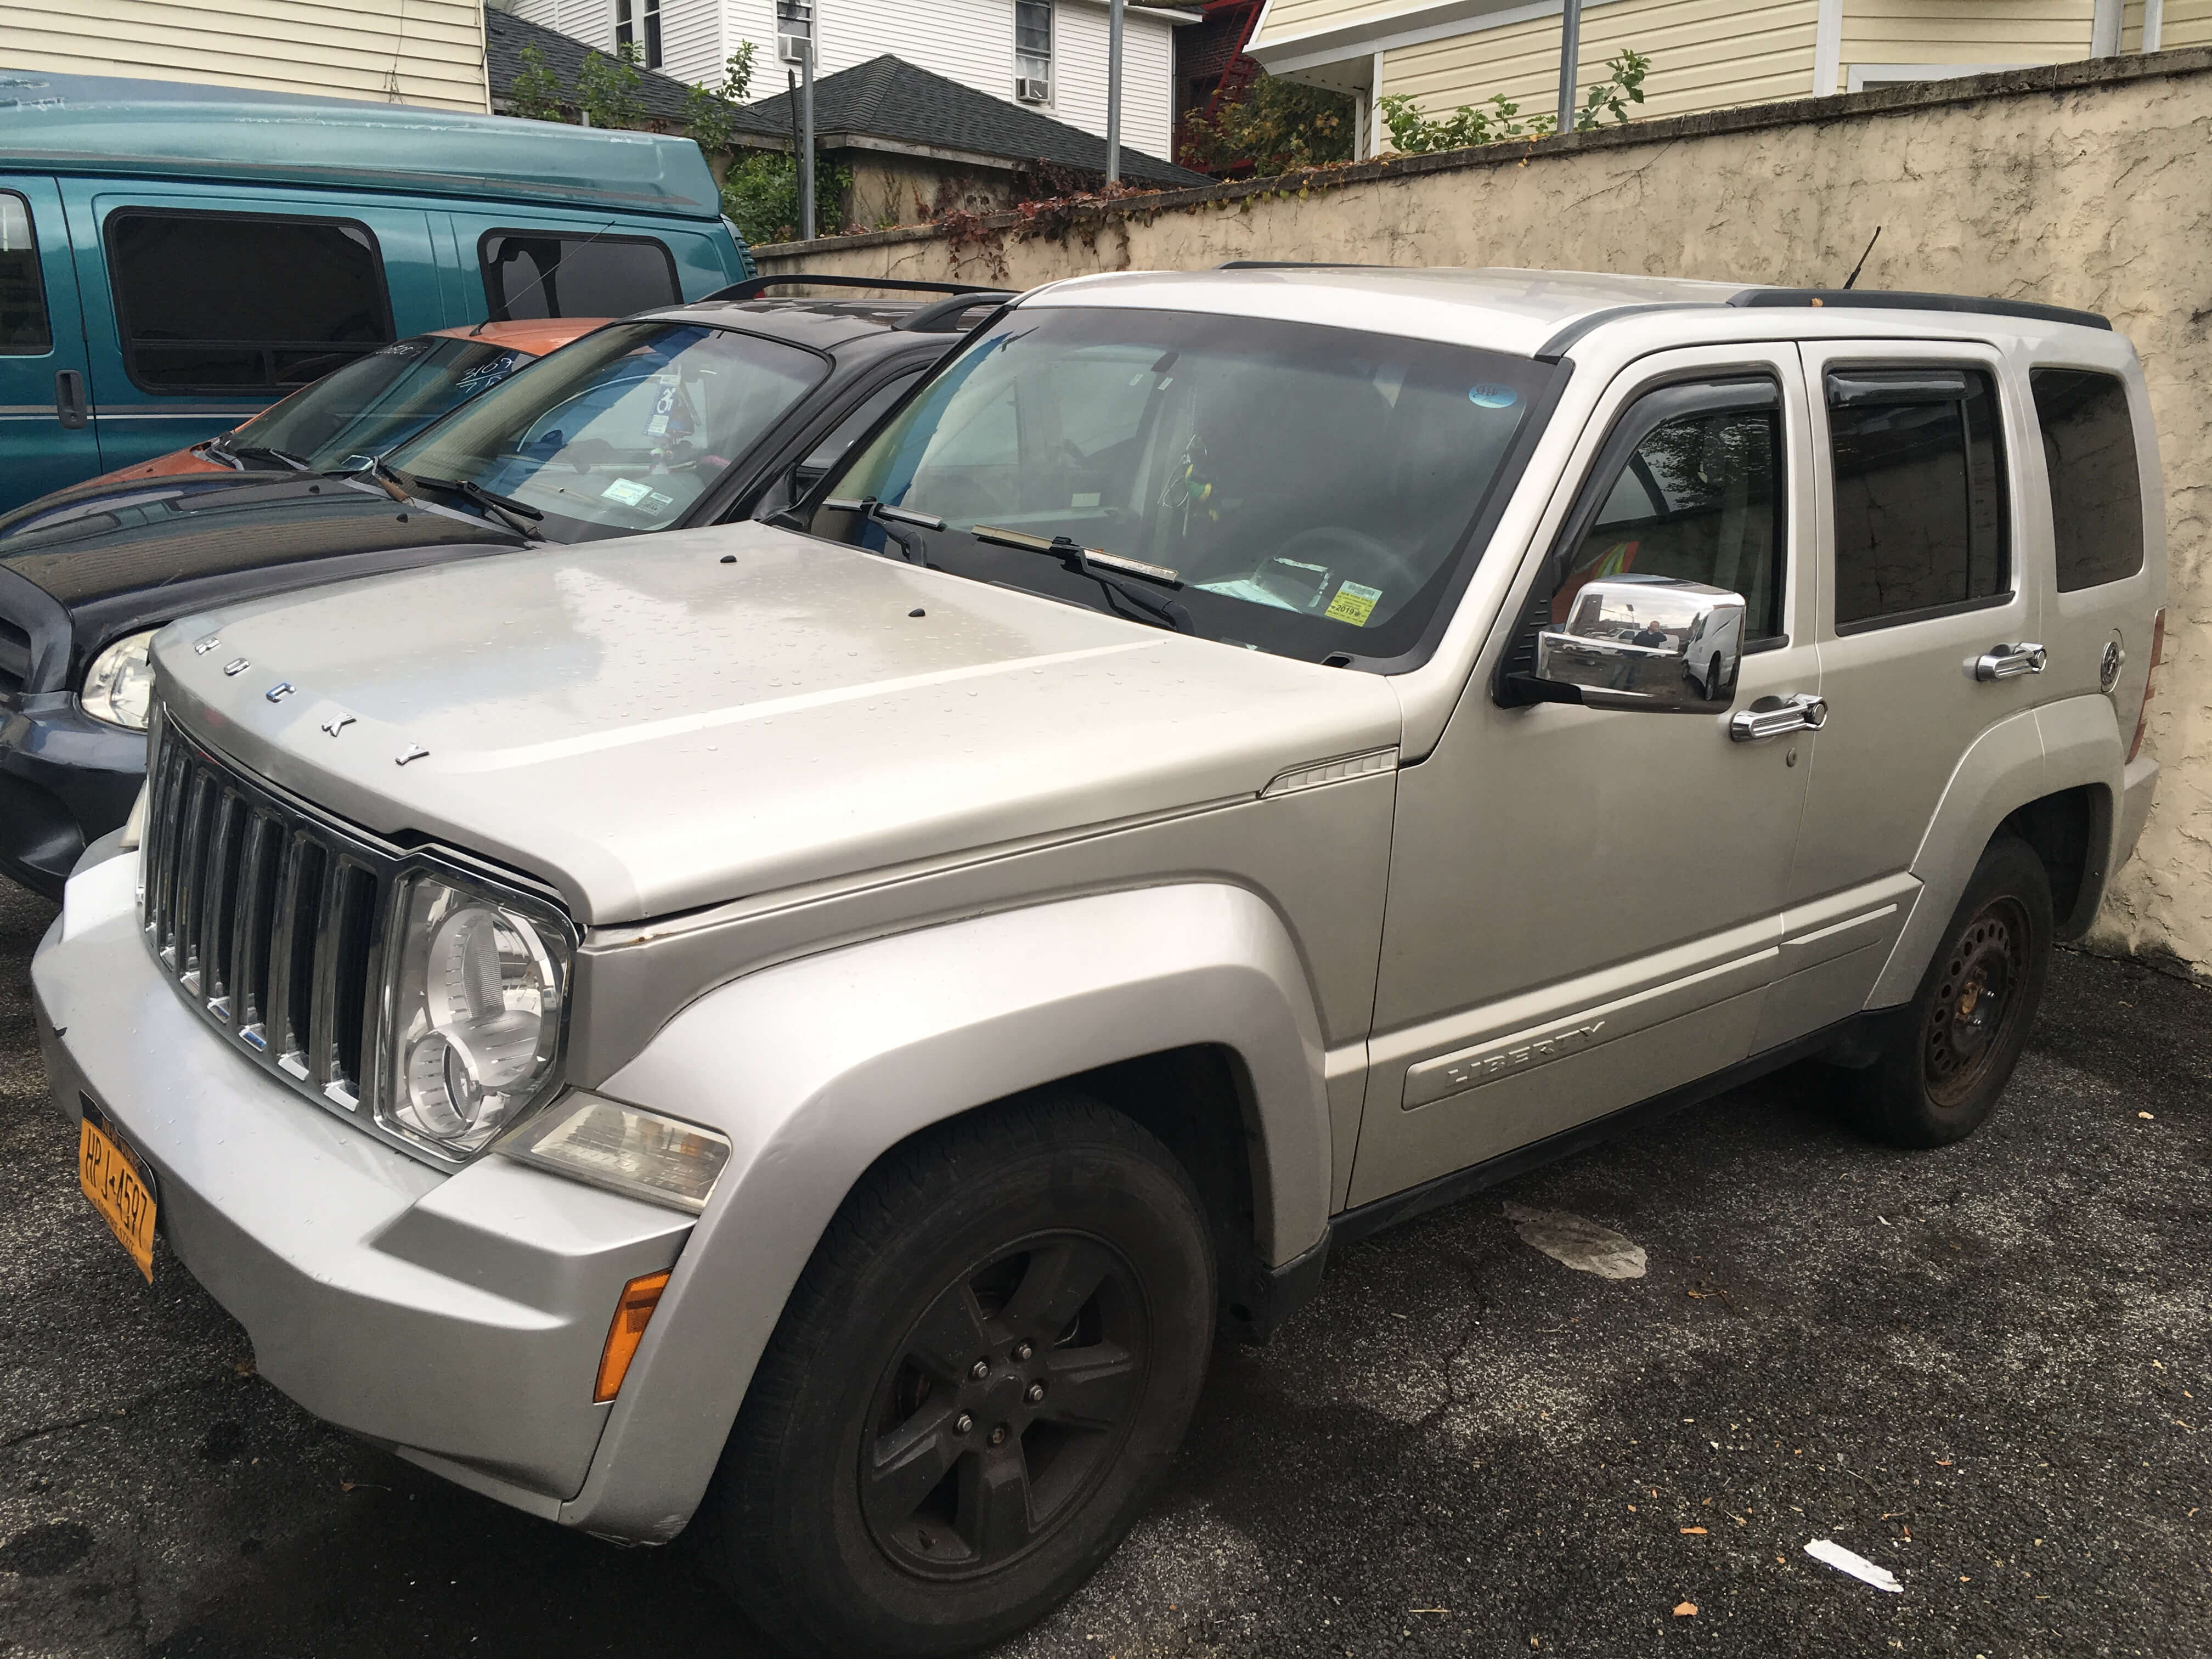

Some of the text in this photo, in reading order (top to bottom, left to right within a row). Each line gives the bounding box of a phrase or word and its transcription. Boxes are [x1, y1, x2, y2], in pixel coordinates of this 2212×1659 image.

[1336, 605, 1355, 615] 2019
[1446, 1021, 1605, 1088] LIBERTY
[118, 1227, 135, 1252] STATE
